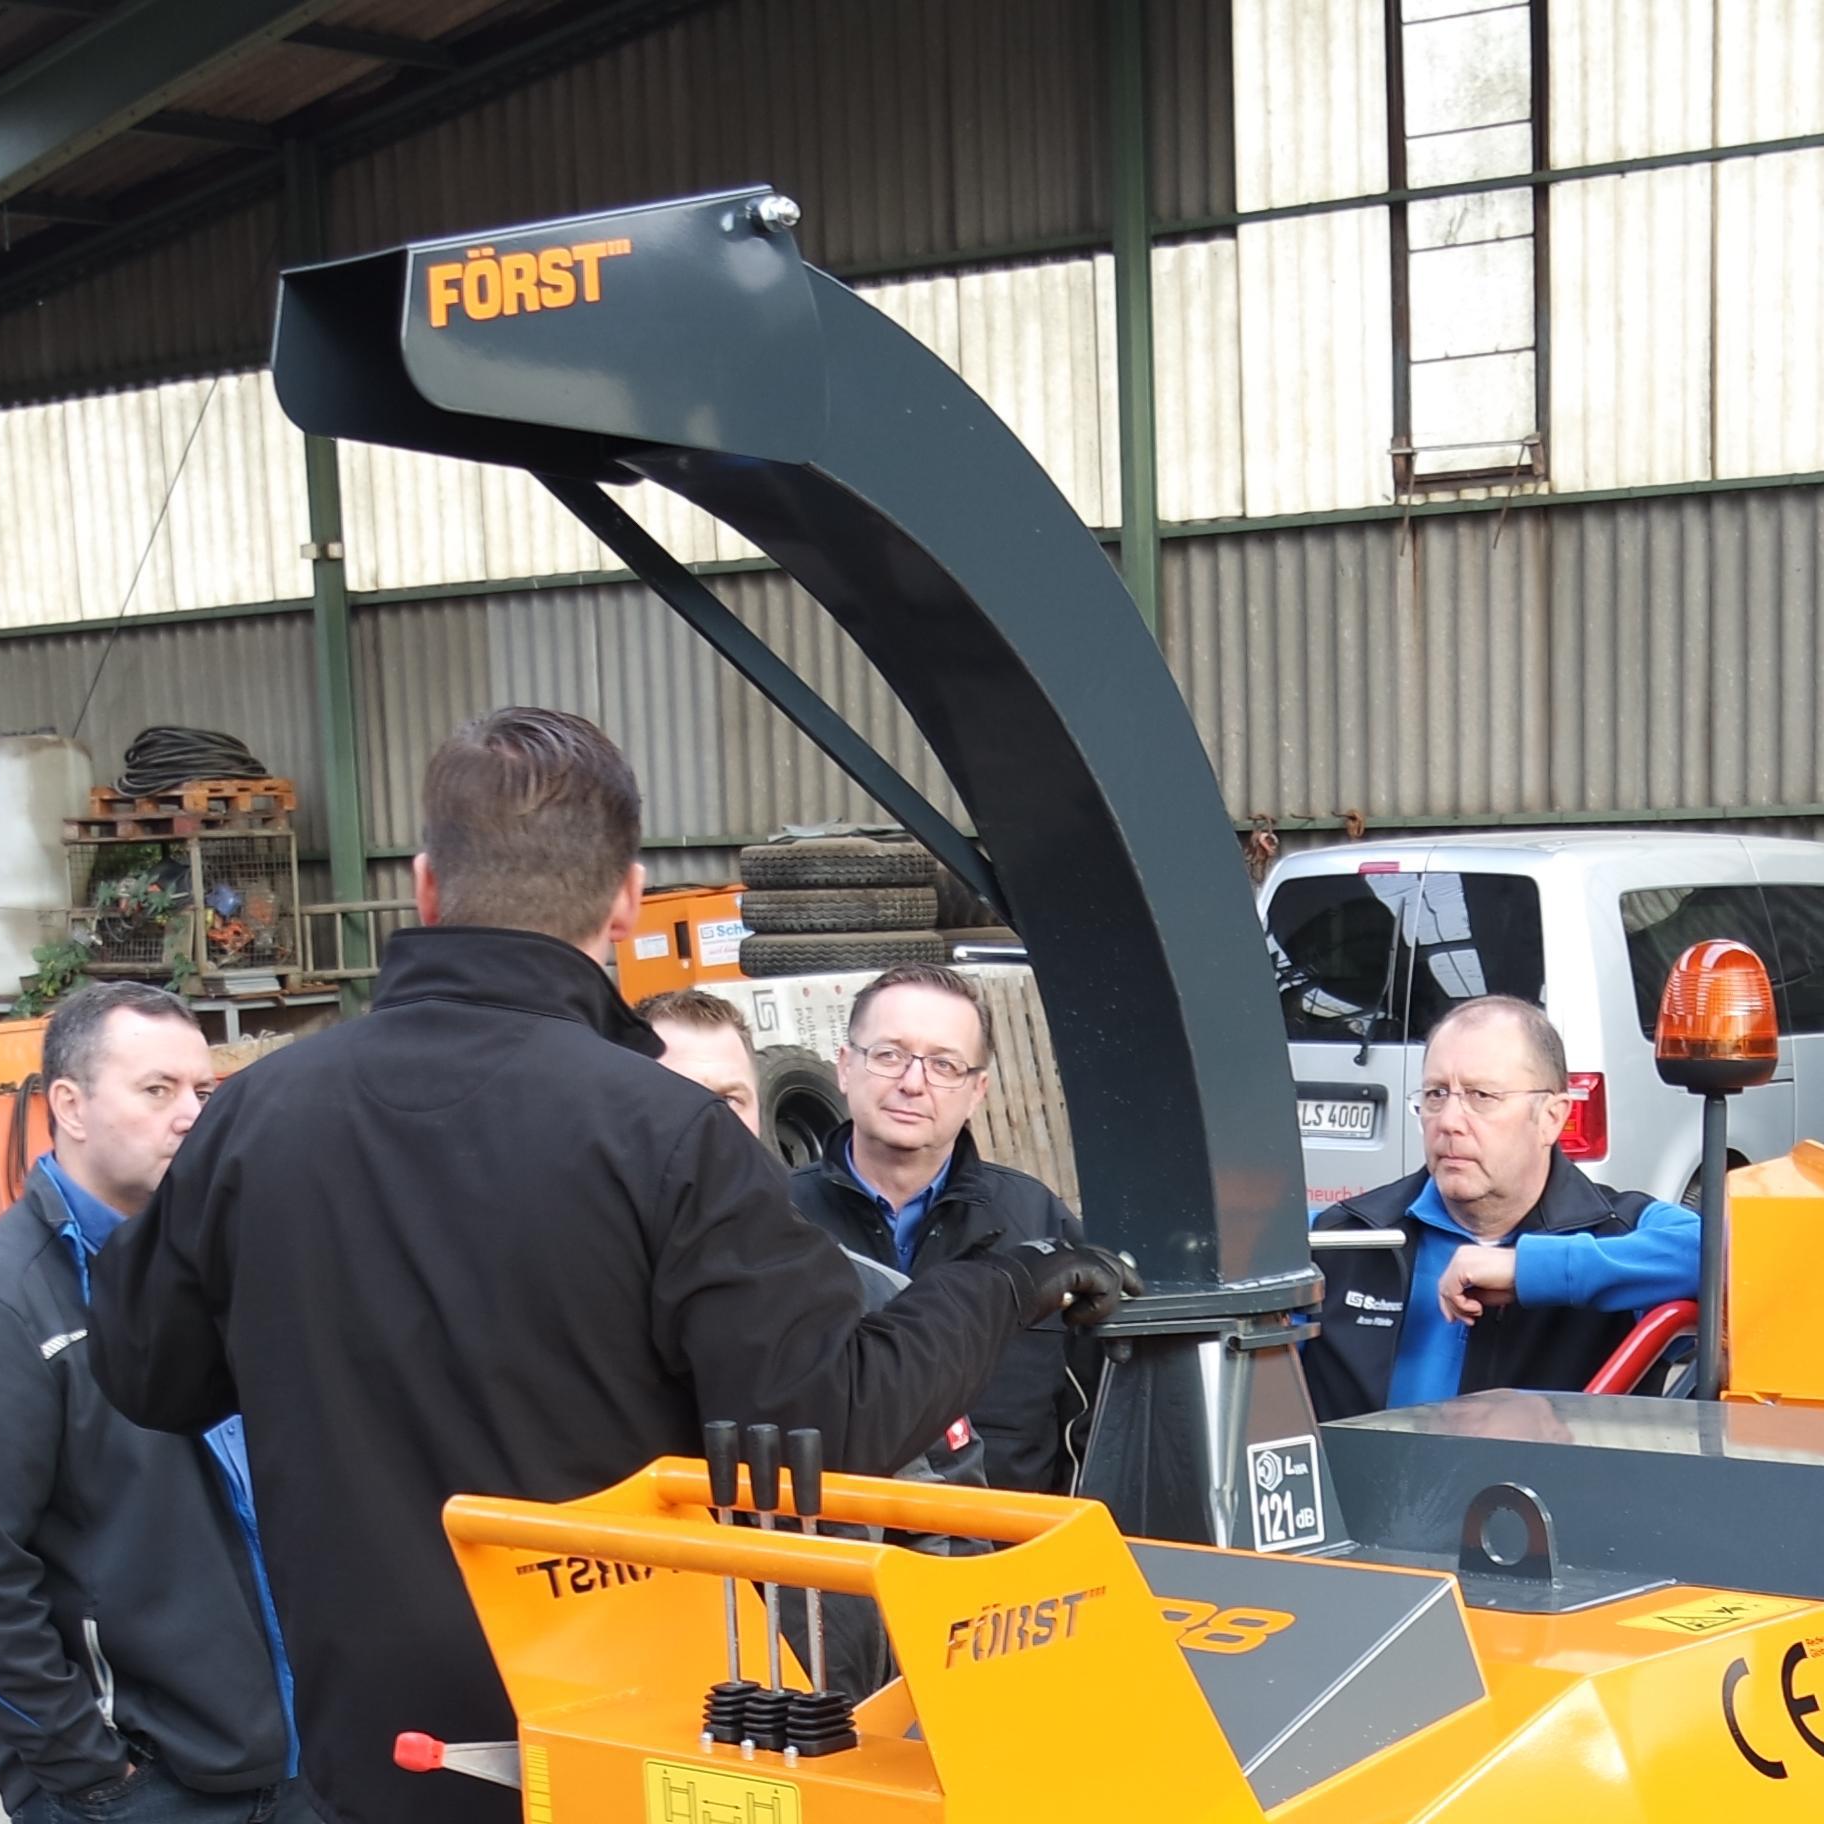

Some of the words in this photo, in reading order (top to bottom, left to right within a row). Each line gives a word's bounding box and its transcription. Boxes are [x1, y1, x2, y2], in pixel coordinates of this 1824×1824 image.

[429, 244, 604, 328] FÖRST
[1302, 1103, 1324, 1126] LS
[1328, 1105, 1371, 1128] 4000
[1260, 1490, 1295, 1542] 121
[1296, 1507, 1315, 1529] dB
[945, 1592, 1087, 1669] FÖRST
